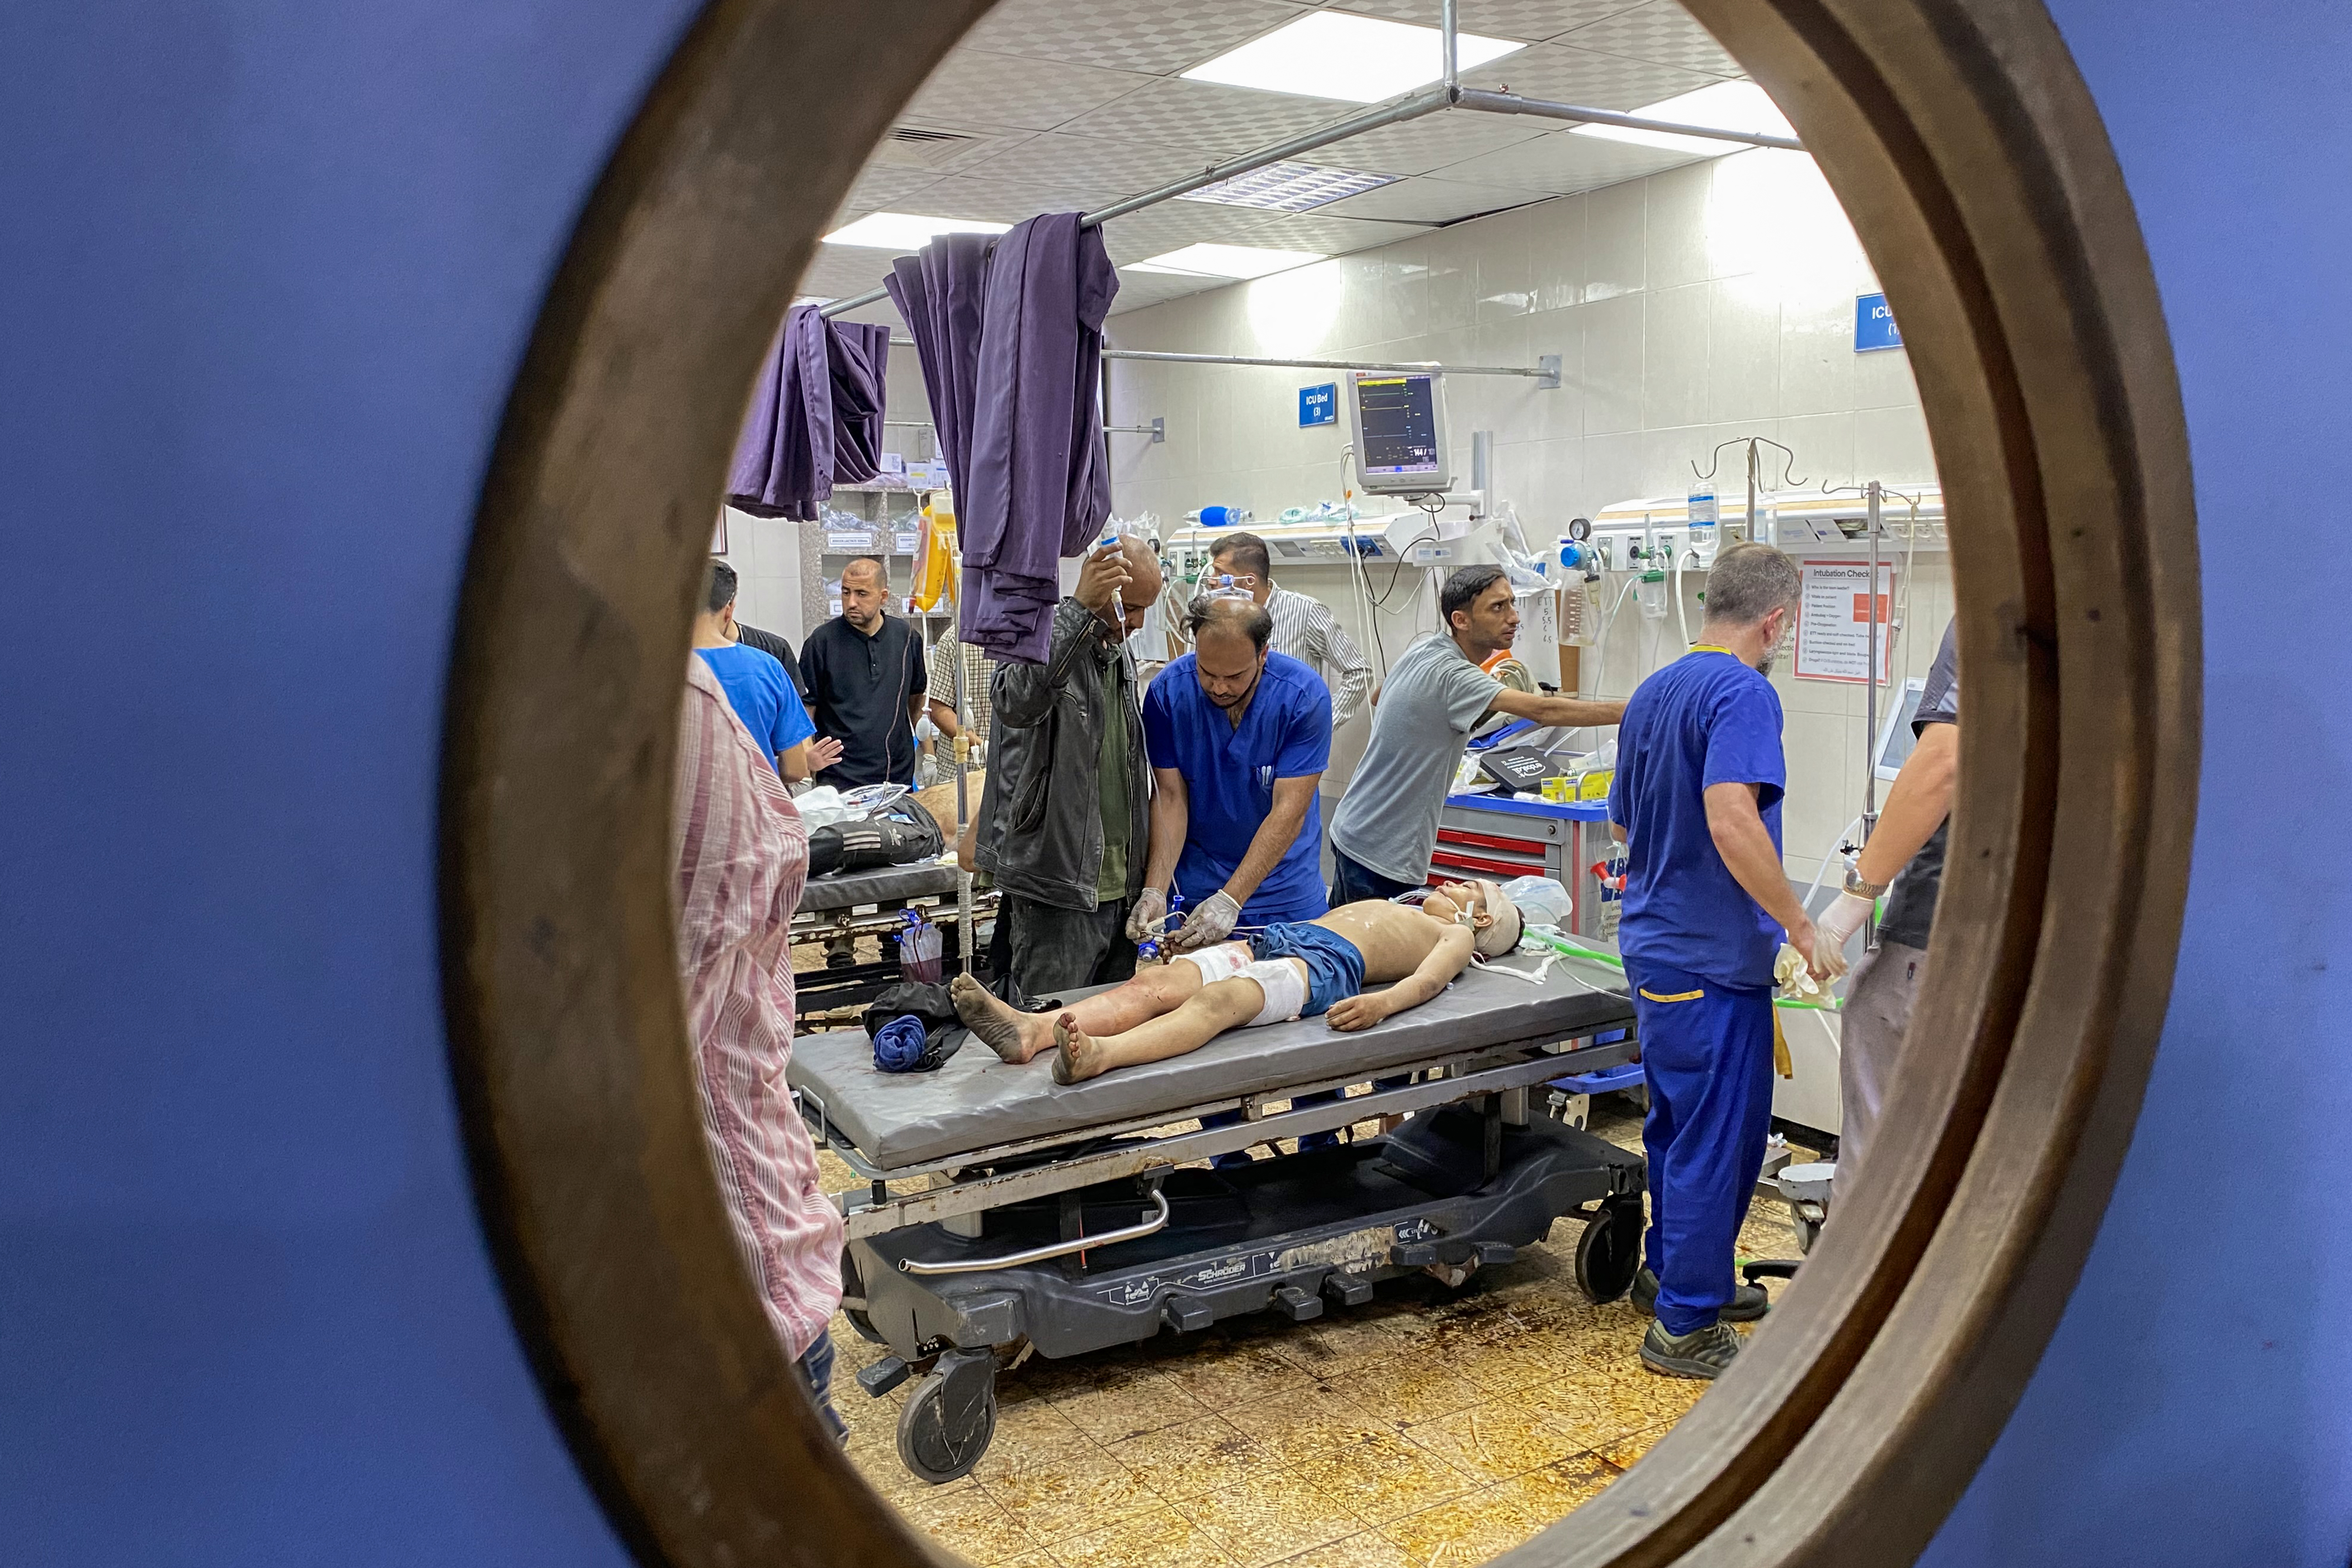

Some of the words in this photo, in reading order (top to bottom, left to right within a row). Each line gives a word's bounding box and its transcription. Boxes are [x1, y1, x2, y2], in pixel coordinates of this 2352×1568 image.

[1872, 305, 1893, 319] ICU
[1306, 395, 1317, 405] ICU
[1317, 392, 1328, 403] Bed
[1813, 569, 1846, 577] Intubation
[1538, 596, 1553, 606] ETT
[1542, 616, 1552, 624] 5.5
[1543, 635, 1552, 643] 6.5
[1198, 1264, 1246, 1281] SCHRÖDER
